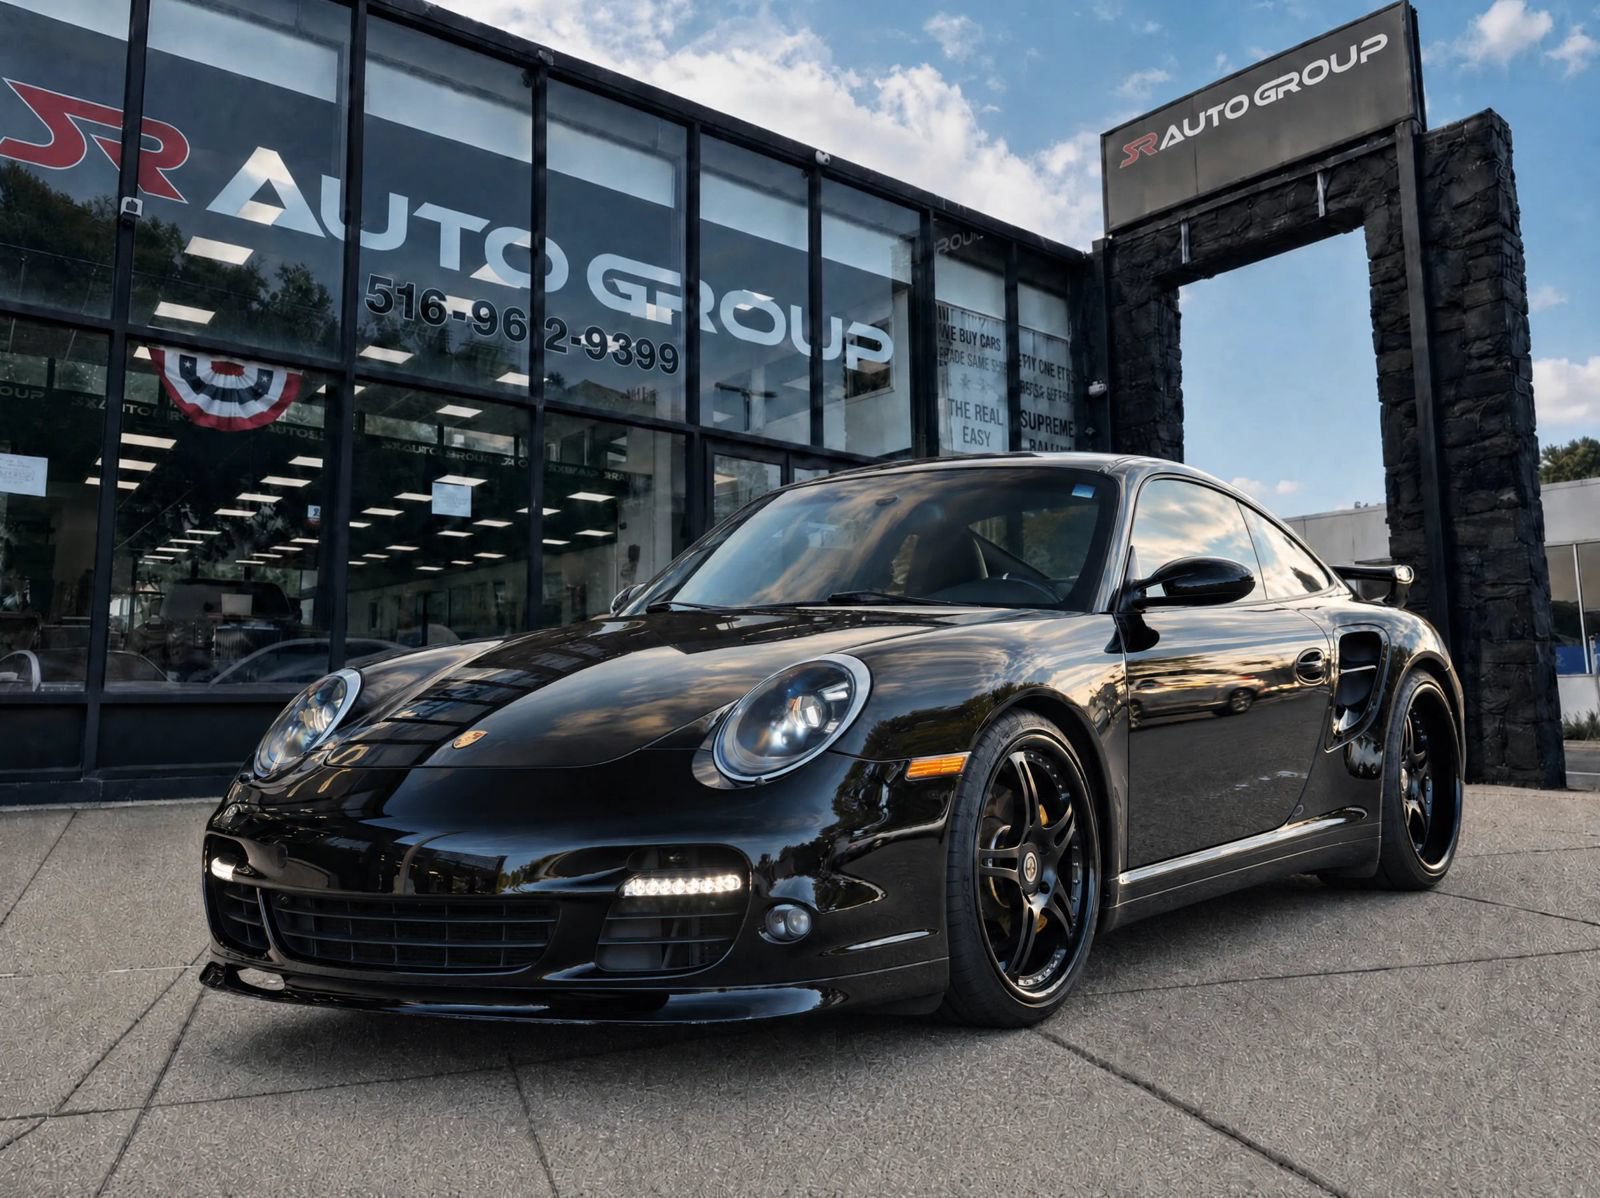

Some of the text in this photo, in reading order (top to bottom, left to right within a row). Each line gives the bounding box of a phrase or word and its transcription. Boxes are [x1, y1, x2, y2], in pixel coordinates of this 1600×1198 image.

[1120, 33, 1388, 169] SR AUTO GROUP
[0, 78, 895, 371] SR AUTO GROUP
[364, 274, 681, 376] 516-962-9399
[959, 328, 978, 346] BUY
[979, 333, 1002, 352] CARS
[948, 398, 1004, 426] THE REAL
[1020, 409, 1075, 438] SUPREME
[962, 426, 992, 448] EASY
